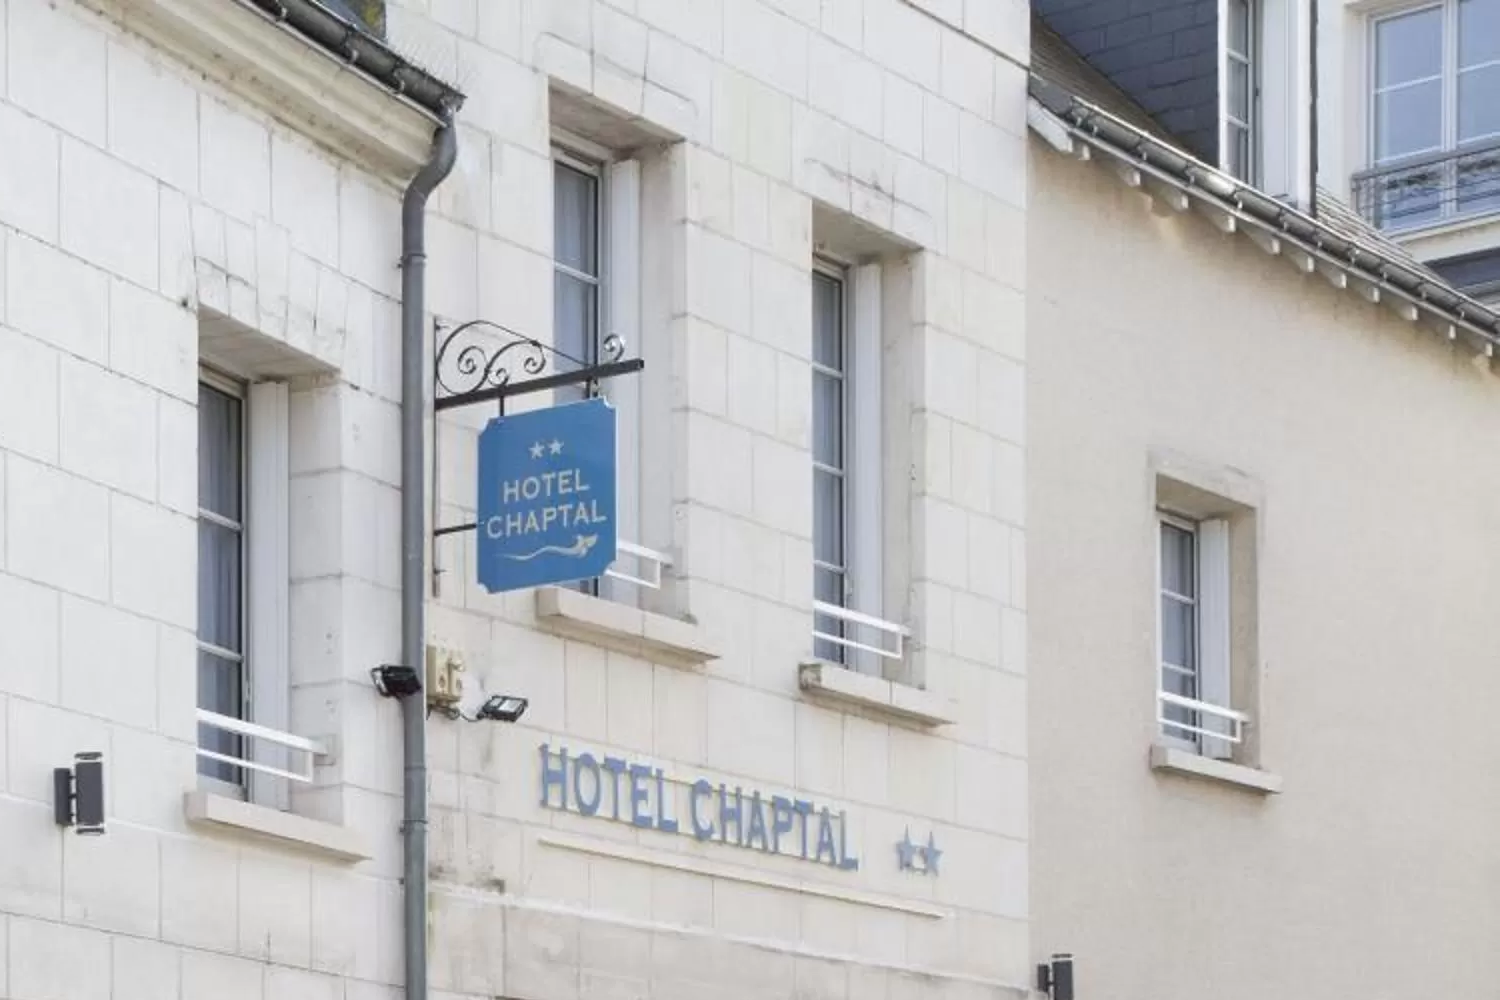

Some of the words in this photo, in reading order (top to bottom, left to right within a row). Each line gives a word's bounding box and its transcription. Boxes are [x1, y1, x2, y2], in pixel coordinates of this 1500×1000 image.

[503, 468, 590, 504] HOTEL
[486, 499, 607, 539] CHAPTAL
[539, 743, 679, 834] HOTEL
[690, 776, 859, 872] CHAPTAL
